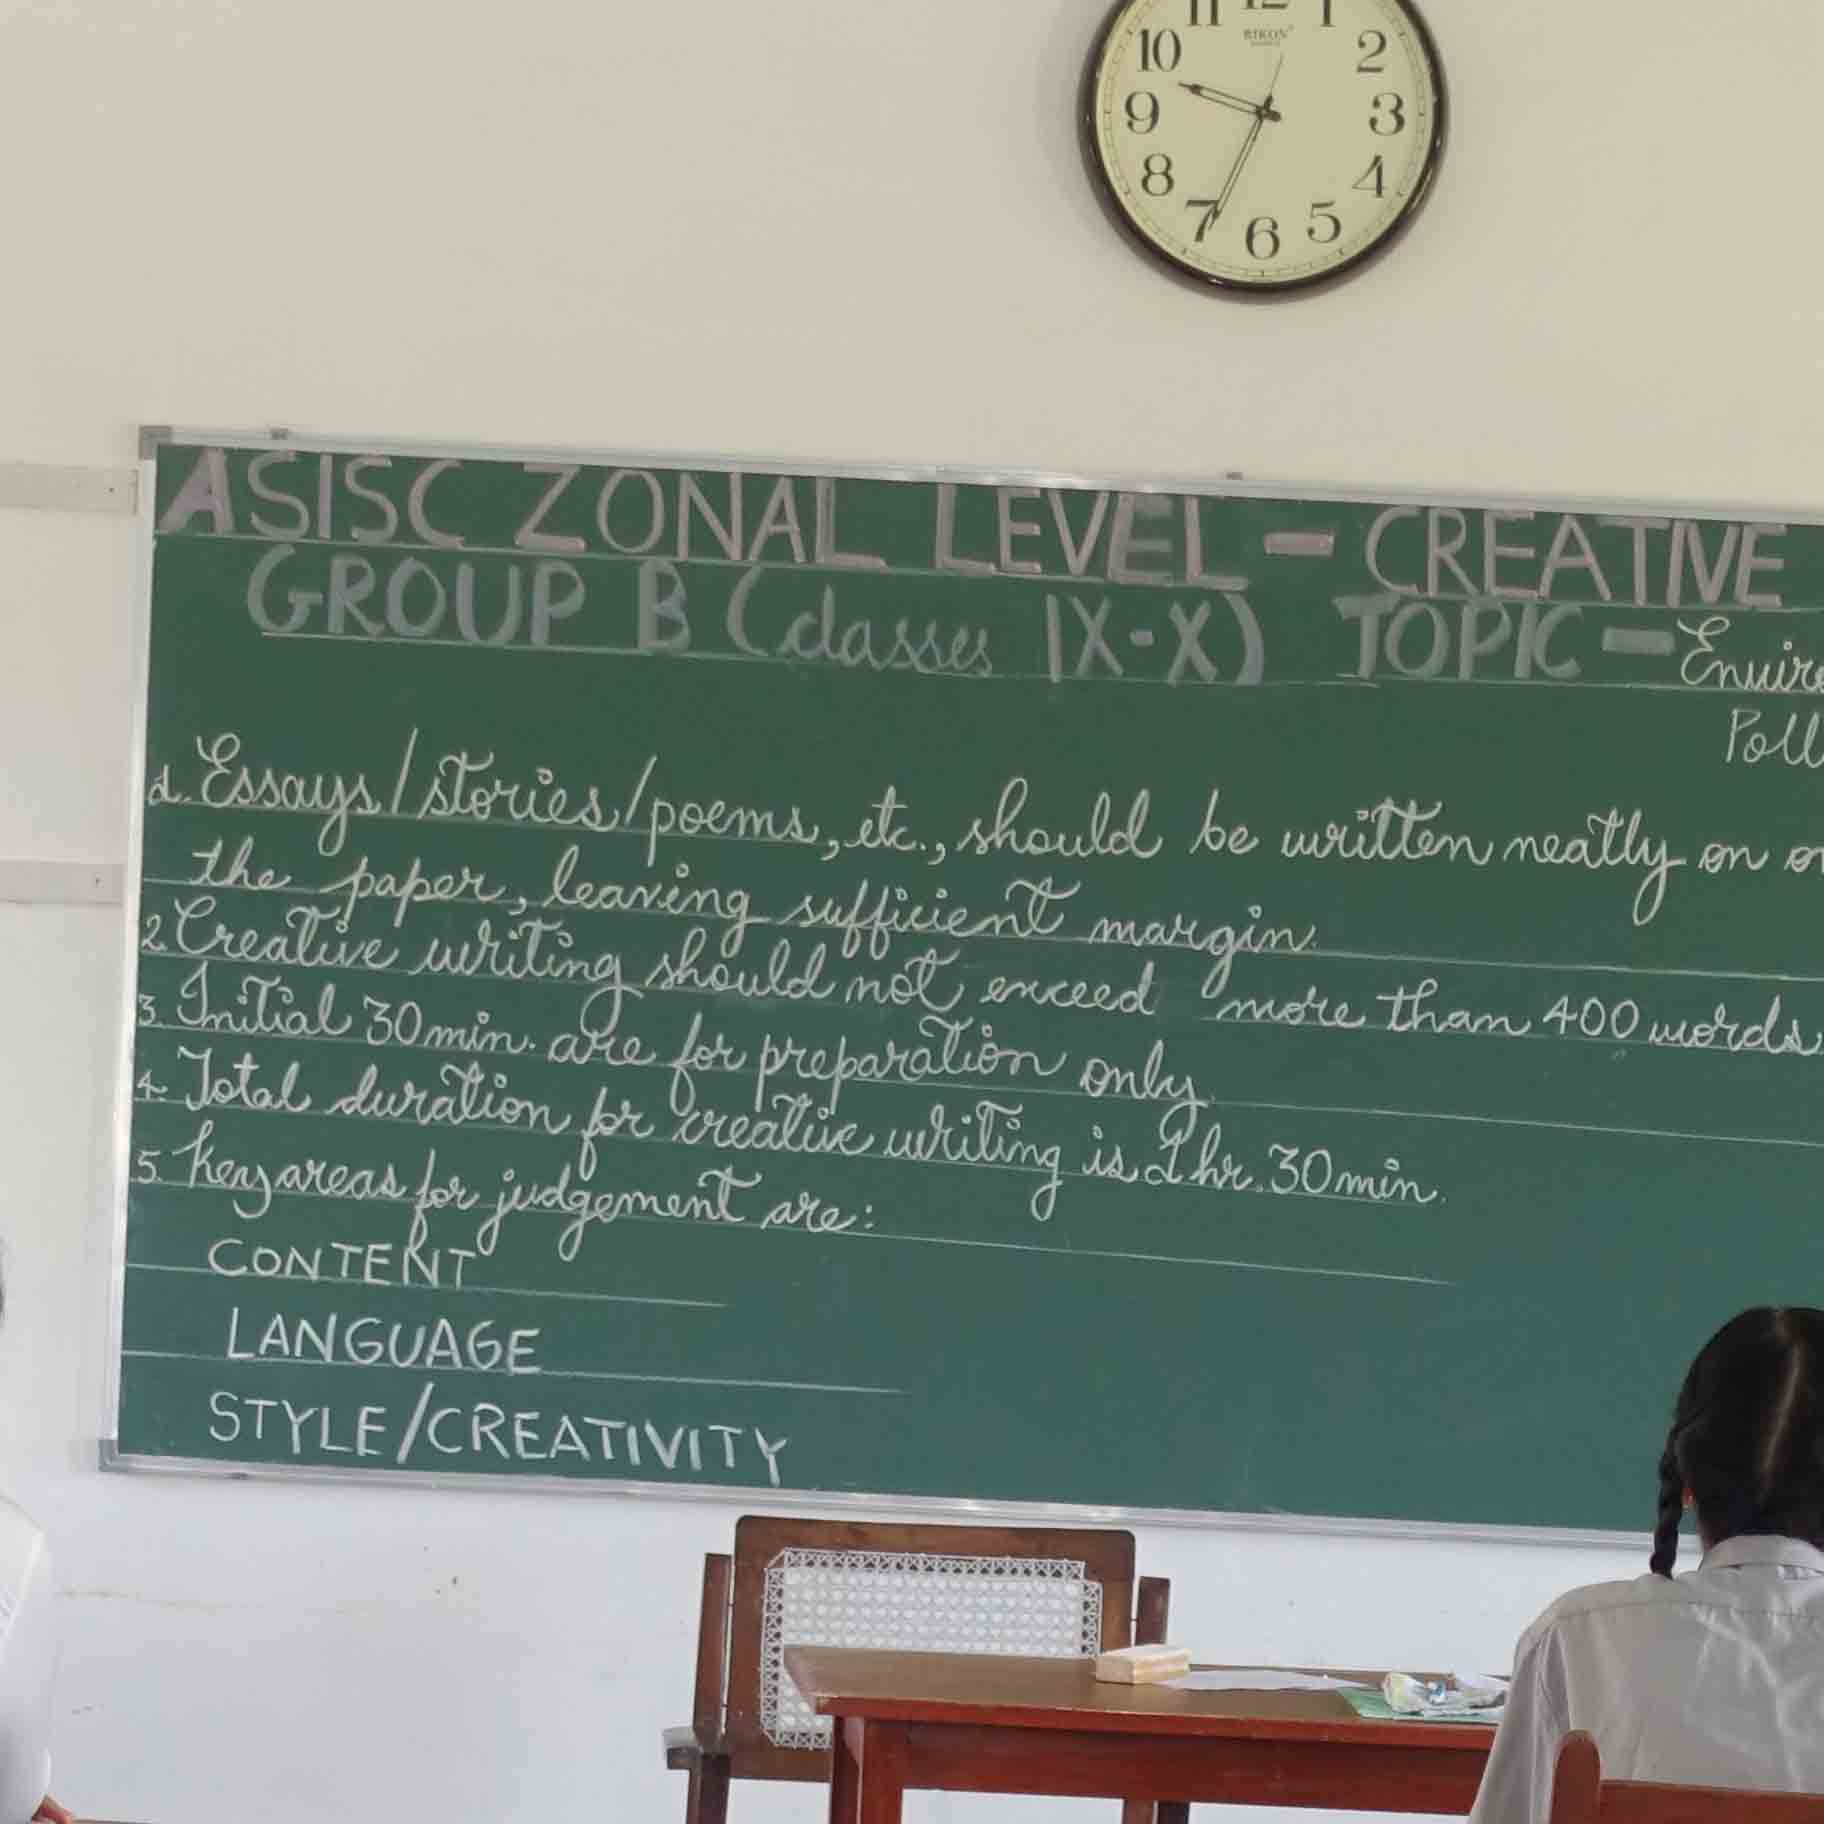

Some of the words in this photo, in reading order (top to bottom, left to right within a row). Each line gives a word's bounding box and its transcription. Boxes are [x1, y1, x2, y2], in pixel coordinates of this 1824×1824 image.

[1137, 29, 1181, 73] 10
[1356, 30, 1386, 73] 2
[1125, 91, 1160, 134] 9
[1369, 92, 1405, 136] 3
[1141, 153, 1174, 196] 8
[1352, 154, 1385, 199] 4
[1185, 200, 1221, 243] 7
[1244, 216, 1280, 260] 6
[1306, 201, 1341, 243] 5
[158, 446, 468, 547] ASISC
[514, 460, 887, 570] ZONAL
[934, 480, 1250, 593] LEVEL
[1364, 504, 1786, 611] CREATIVE
[246, 544, 587, 649] GROUP
[635, 558, 692, 655] B
[1335, 594, 1584, 682] TOPIC
[956, 776, 1162, 859] should
[1189, 789, 1259, 855] be
[1281, 797, 1493, 866] written
[1504, 806, 1687, 925] neatly
[1698, 841, 1769, 874] on
[191, 835, 292, 893] the
[541, 846, 772, 959] leaving
[777, 878, 1081, 960] sufficient
[175, 895, 400, 974] Creative
[409, 920, 644, 1040] writing
[645, 925, 840, 1002] should
[844, 946, 964, 1012] not
[979, 960, 1157, 1016] exceed
[1216, 985, 1366, 1030] more
[1376, 978, 1533, 1036] than
[1542, 994, 1640, 1041] 400
[176, 961, 353, 1038] Initial
[548, 1027, 658, 1067] are
[668, 1011, 748, 1117] for
[754, 1014, 1069, 1115] preparation
[176, 1045, 313, 1115] Total
[324, 1060, 572, 1136] duration
[576, 1086, 655, 1181] for
[676, 1093, 876, 1156] creative
[882, 1100, 1062, 1222] writing
[408, 1148, 481, 1252] for
[477, 1163, 763, 1263] judgement
[207, 1236, 477, 1291] CONTENT
[224, 1305, 544, 1375] LANGUAGE
